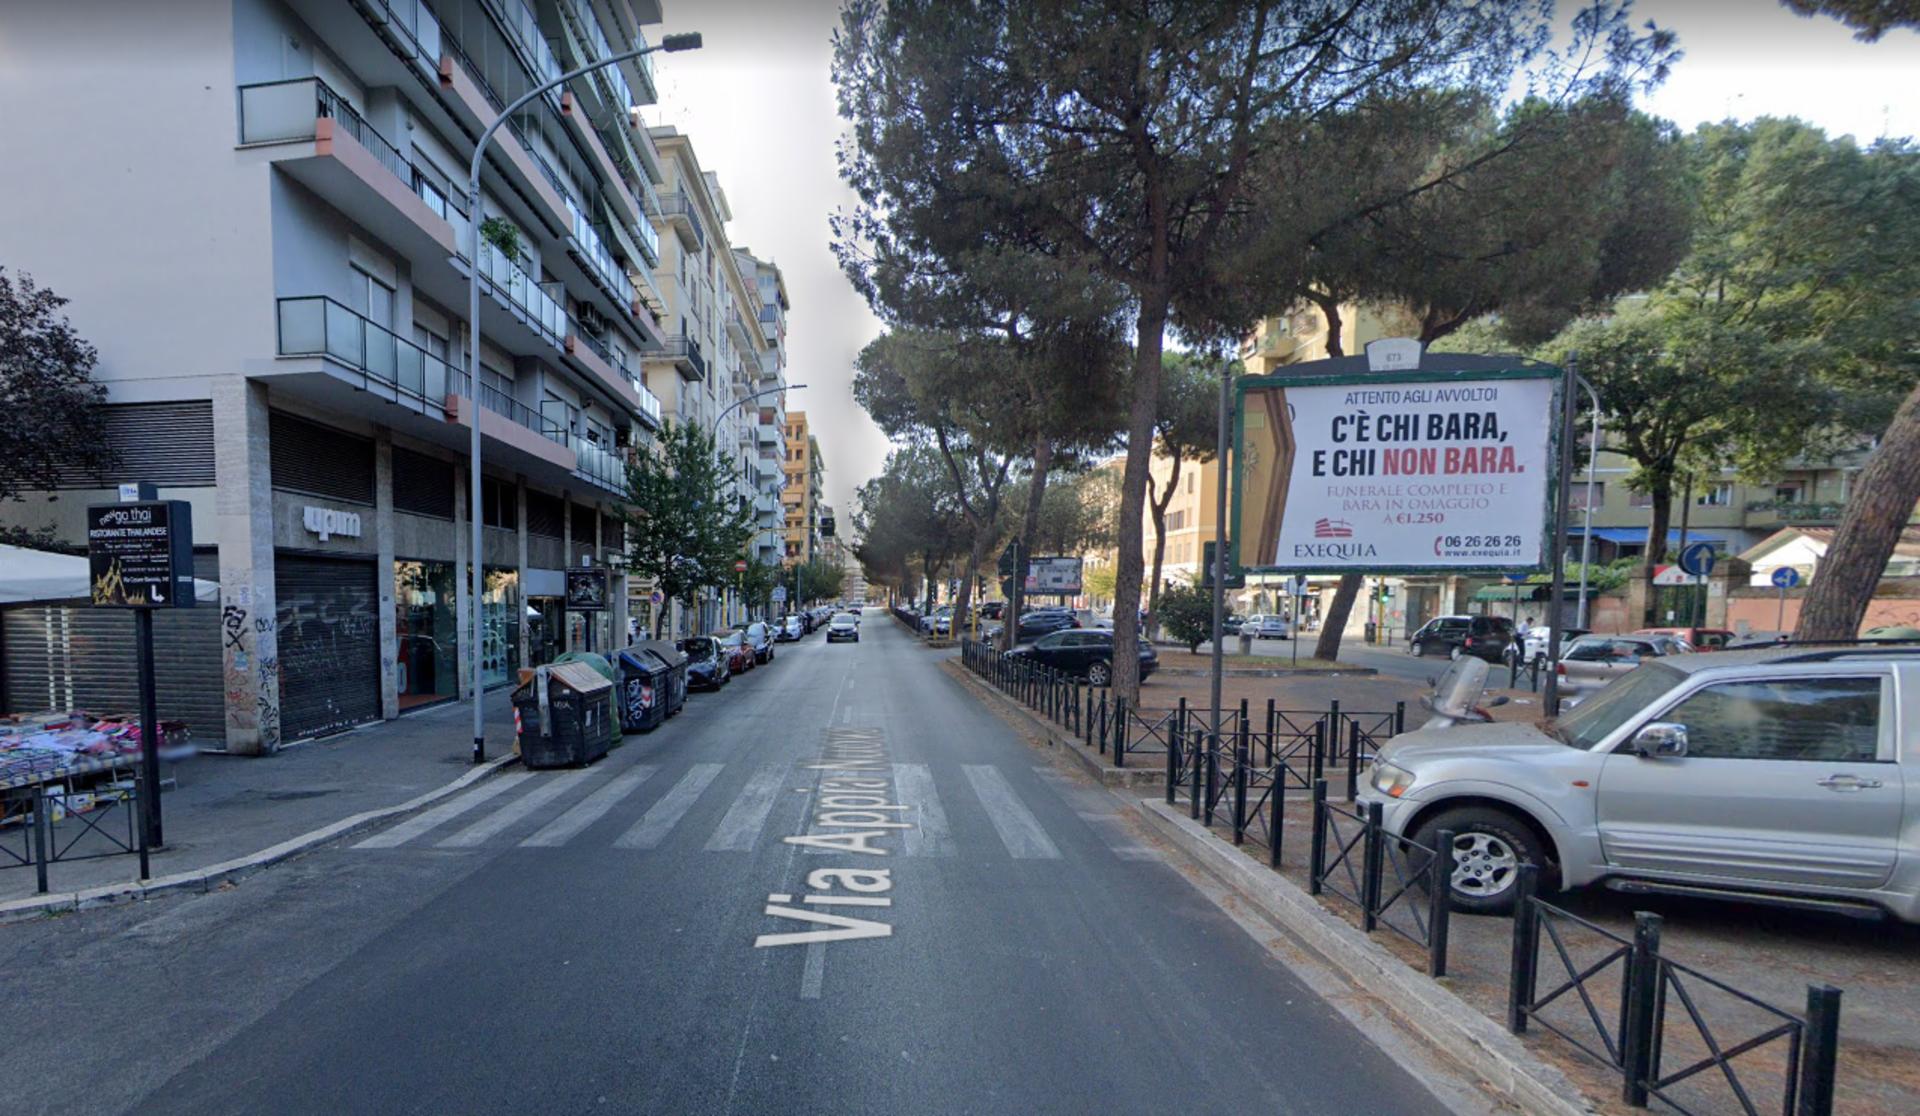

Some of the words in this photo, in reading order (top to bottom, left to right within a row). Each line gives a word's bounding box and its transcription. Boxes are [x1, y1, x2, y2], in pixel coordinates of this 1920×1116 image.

[1345, 391, 1400, 405] ATTENTO
[1403, 390, 1432, 403] AGLI
[1435, 387, 1498, 402] AVVOLTOI
[1332, 410, 1370, 443] C'È
[1377, 414, 1420, 441] CHI
[1427, 412, 1508, 442] BARA,
[1313, 450, 1326, 476] E
[1332, 449, 1375, 475] CHI
[1382, 448, 1437, 475] NON
[1444, 446, 1525, 474] BARA.
[1328, 484, 1401, 497] FUNERALE
[1408, 483, 1494, 496] COMPLETO
[1500, 483, 1510, 495] E
[1343, 499, 1381, 511] BARA
[1386, 499, 1402, 510] IN
[1408, 498, 1489, 510] OMAGGIO
[130, 507, 151, 520] thai
[1383, 514, 1393, 525] A
[304, 506, 360, 541] upim
[90, 529, 126, 537] RISTORANTE
[127, 527, 168, 537] THAILANDESE
[1445, 536, 1461, 547] 06
[1465, 536, 1480, 547] 26
[1485, 536, 1501, 547] 26
[1505, 535, 1521, 547] 26
[1294, 543, 1377, 561] EXEQUIA
[1445, 549, 1521, 557] www.exequia.it
